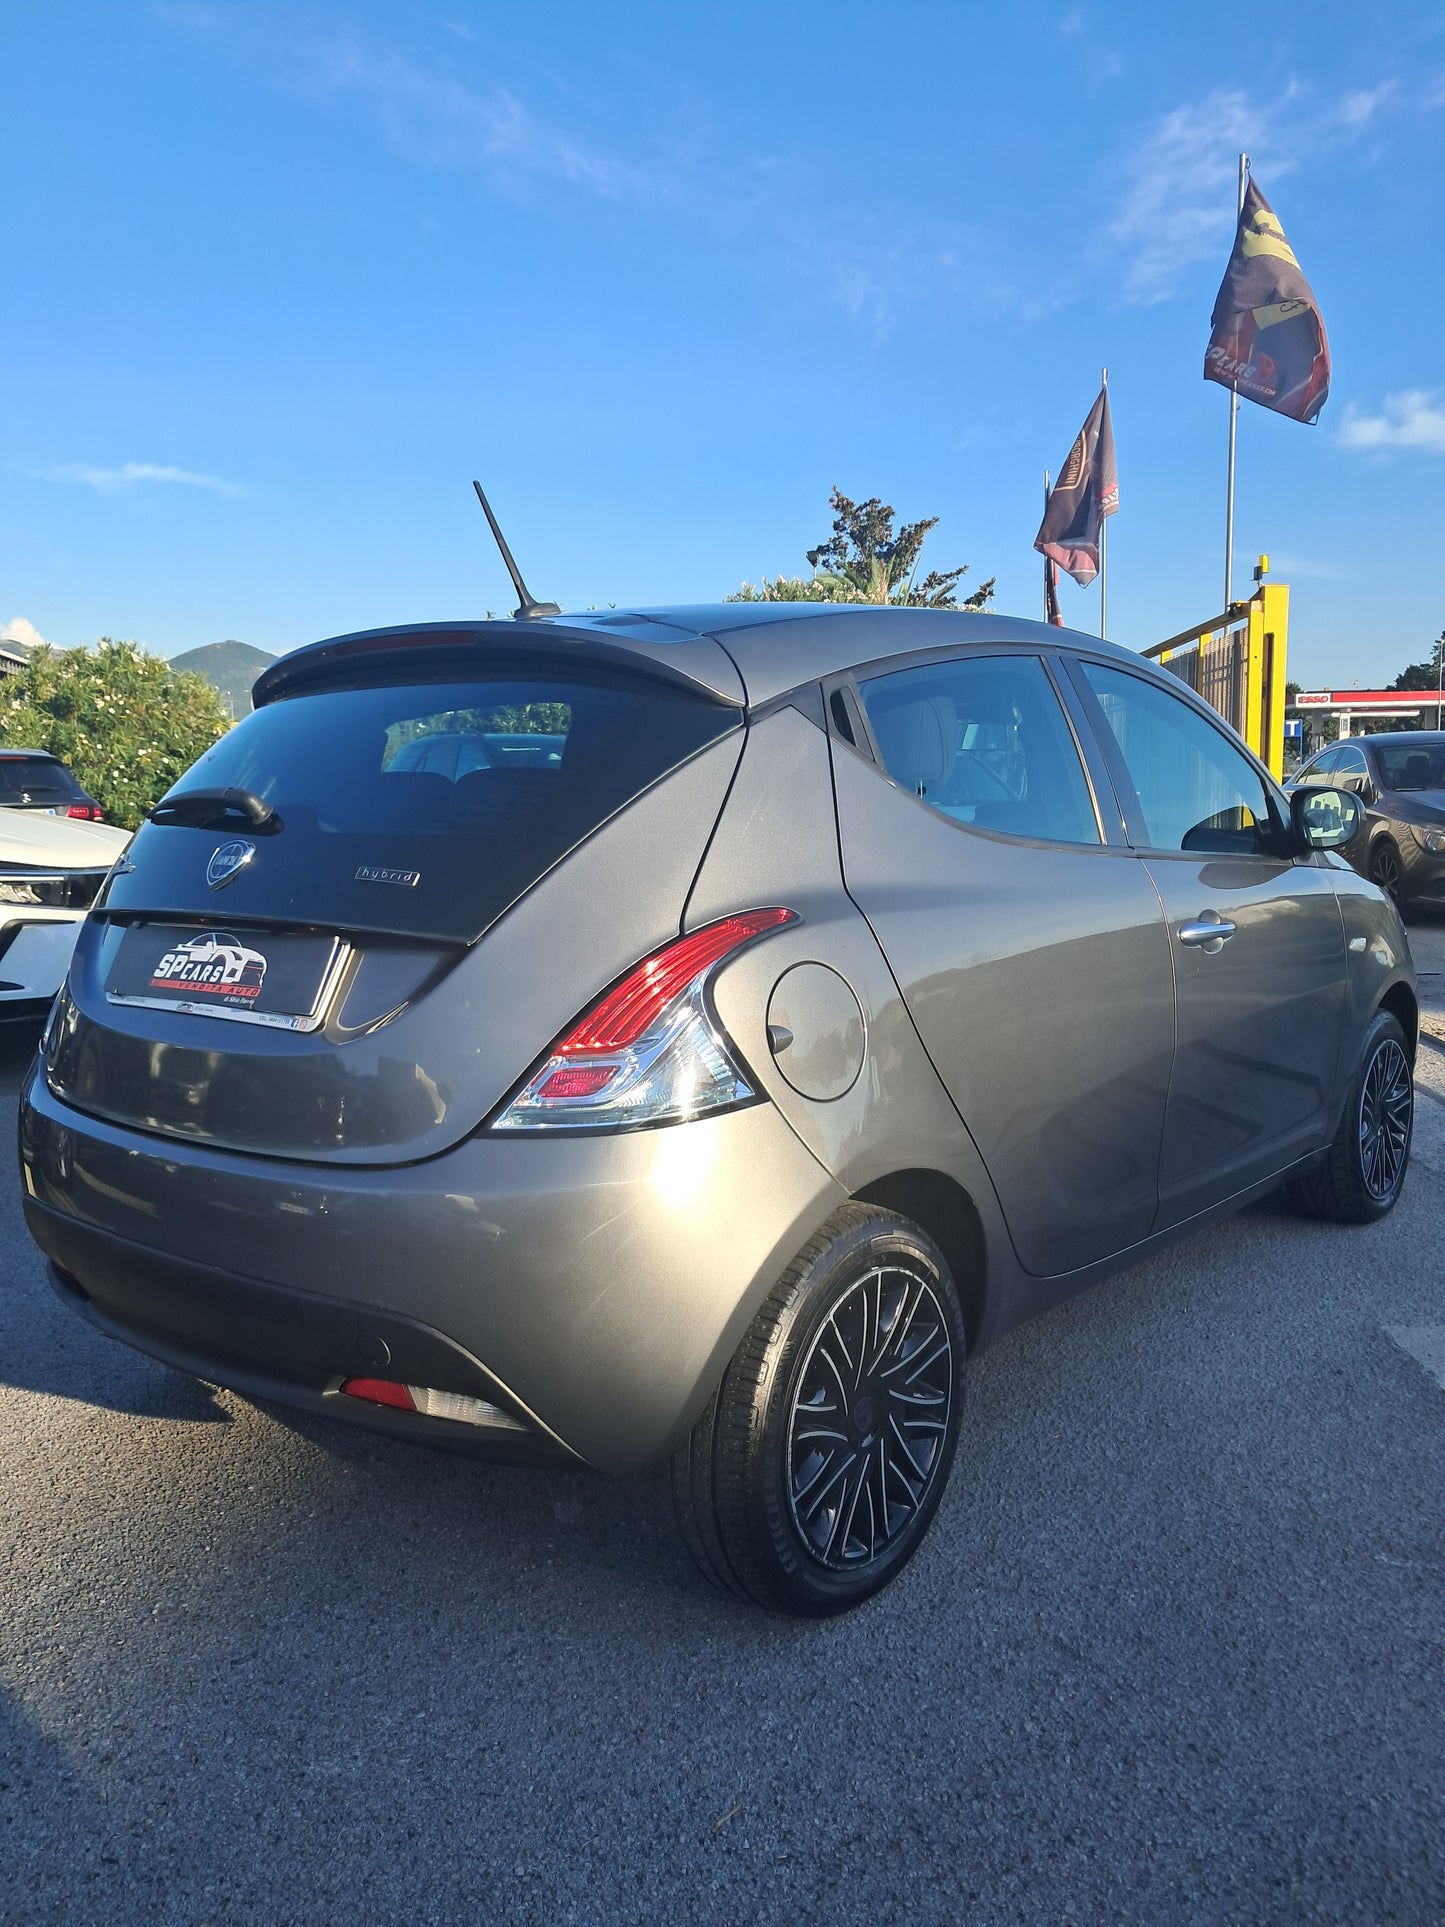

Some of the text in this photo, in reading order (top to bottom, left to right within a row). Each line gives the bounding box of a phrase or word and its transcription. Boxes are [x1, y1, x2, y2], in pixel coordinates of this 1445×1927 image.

[361, 867, 413, 882] hybrid
[178, 981, 258, 998] VENDITA AUTO
